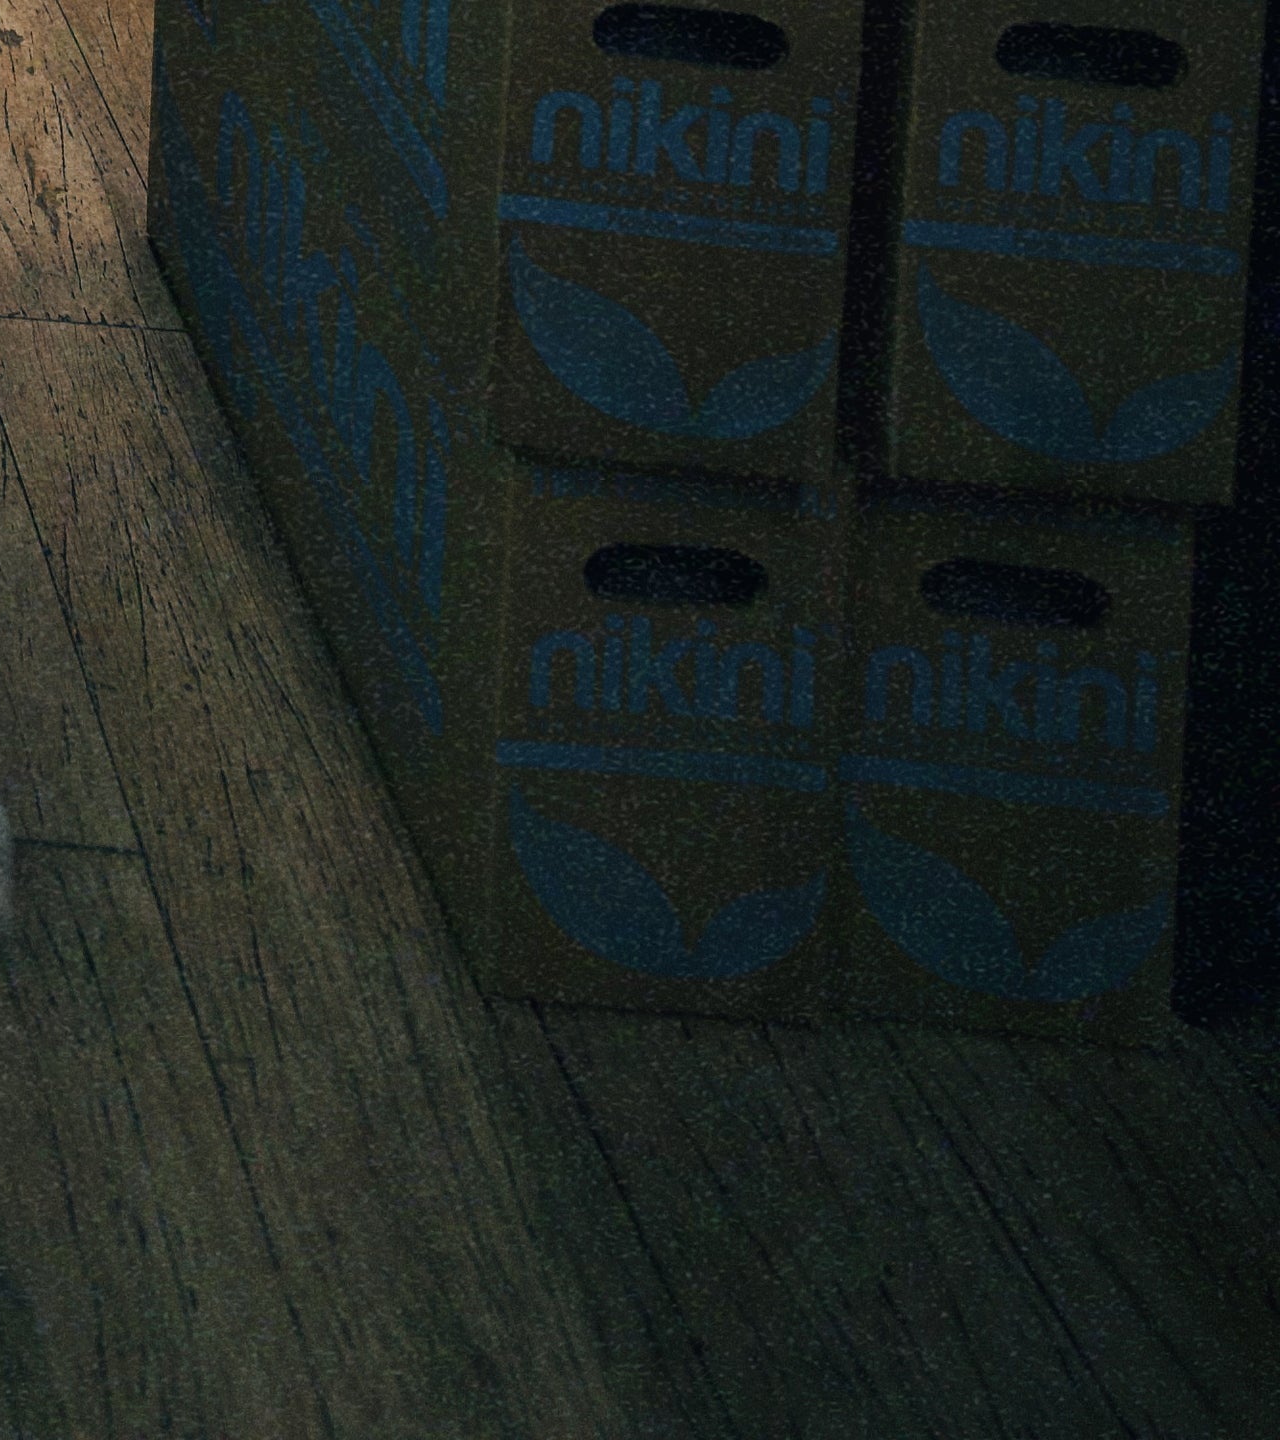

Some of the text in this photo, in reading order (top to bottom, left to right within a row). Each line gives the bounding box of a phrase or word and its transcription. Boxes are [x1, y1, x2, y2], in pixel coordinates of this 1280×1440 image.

[531, 74, 833, 196] nikini
[937, 93, 1234, 213] nikini
[530, 612, 817, 729] nikini
[864, 629, 1158, 756] nikini
